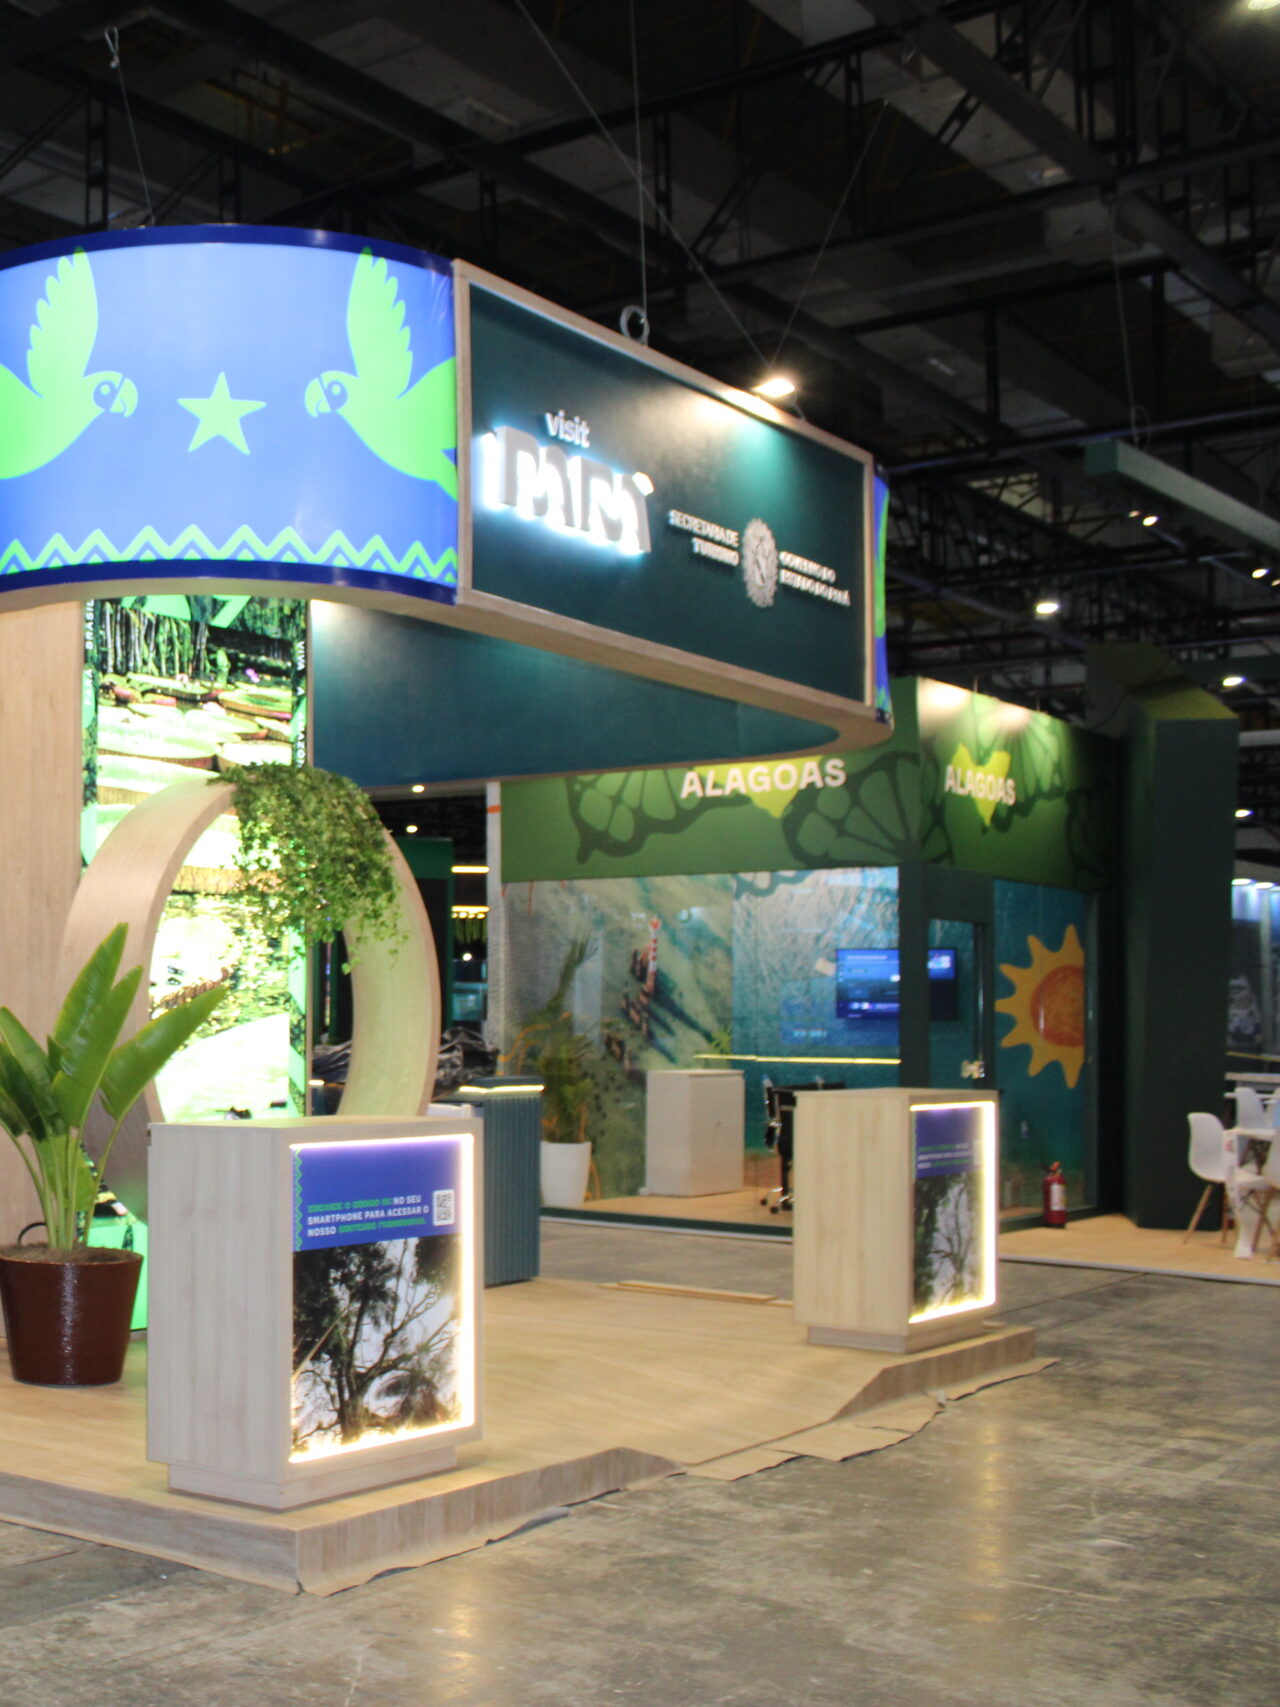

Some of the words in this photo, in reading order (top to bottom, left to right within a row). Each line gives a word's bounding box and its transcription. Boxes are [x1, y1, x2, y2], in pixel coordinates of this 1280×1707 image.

[545, 410, 590, 449] visit
[85, 598, 95, 650] BRASIL
[296, 641, 306, 670] VIVA
[296, 712, 306, 768] AMAZÔN
[680, 758, 847, 799] ALAGOAS
[944, 764, 1016, 806] ALAGOAS
[307, 1212, 363, 1225] SMARTPHONE
[364, 1208, 385, 1219] PARA
[387, 1206, 422, 1217] ACESSAR
[423, 1205, 429, 1213] O
[393, 1196, 404, 1205] NO
[406, 1195, 421, 1204] SEU
[307, 1226, 337, 1237] NOSSO
